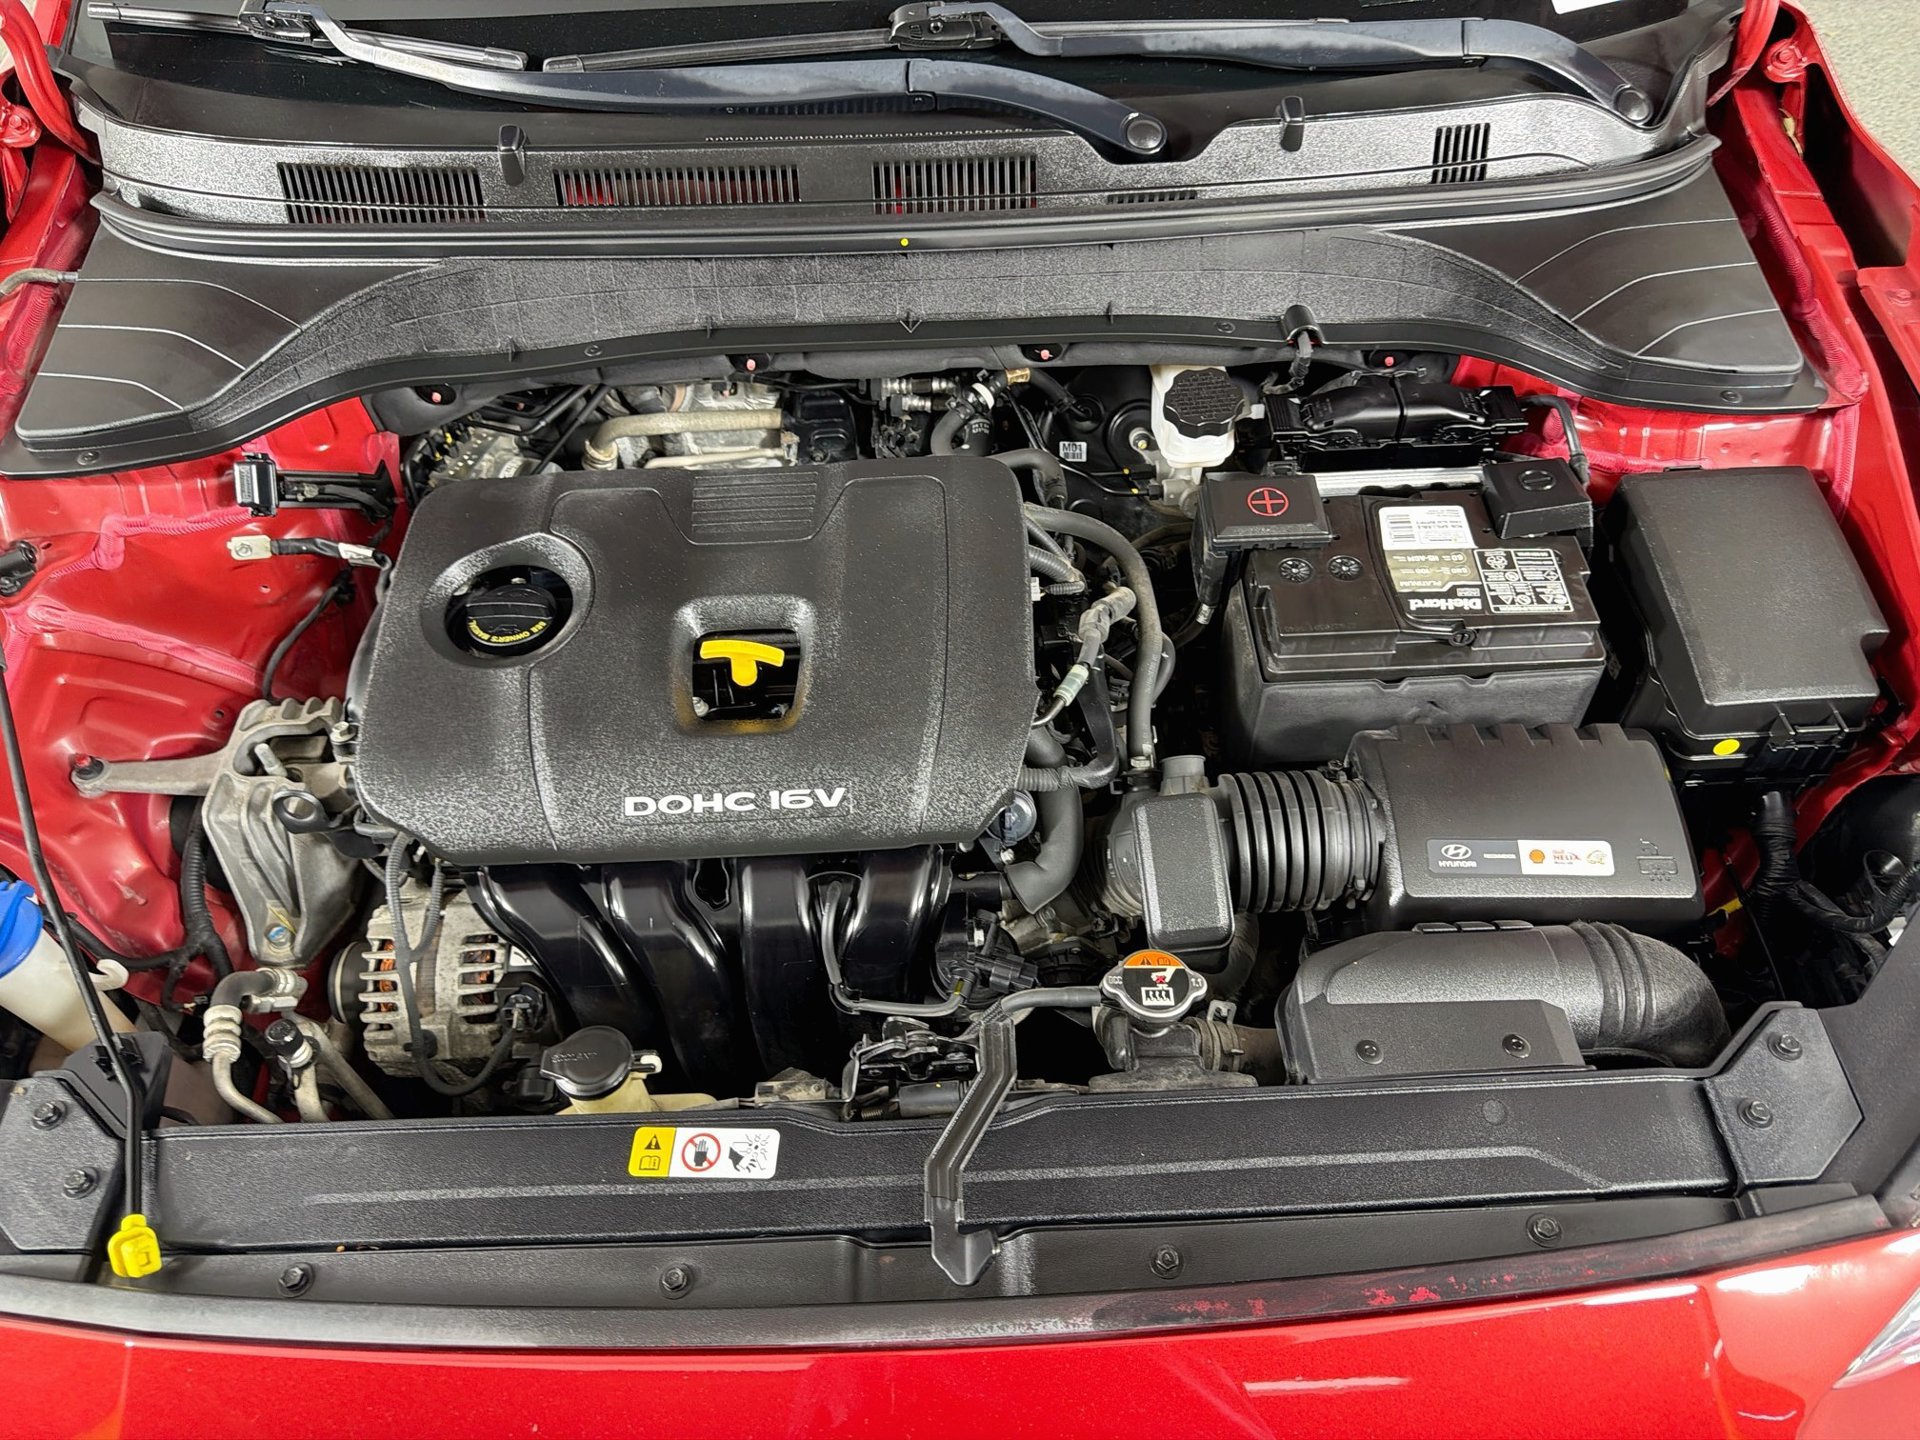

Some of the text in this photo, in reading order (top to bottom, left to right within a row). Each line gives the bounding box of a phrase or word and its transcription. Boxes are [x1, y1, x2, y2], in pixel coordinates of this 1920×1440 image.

[1409, 598, 1482, 610] DieHard
[624, 787, 847, 816] DOHC 16V
[1438, 860, 1478, 868] HYUNDAI
